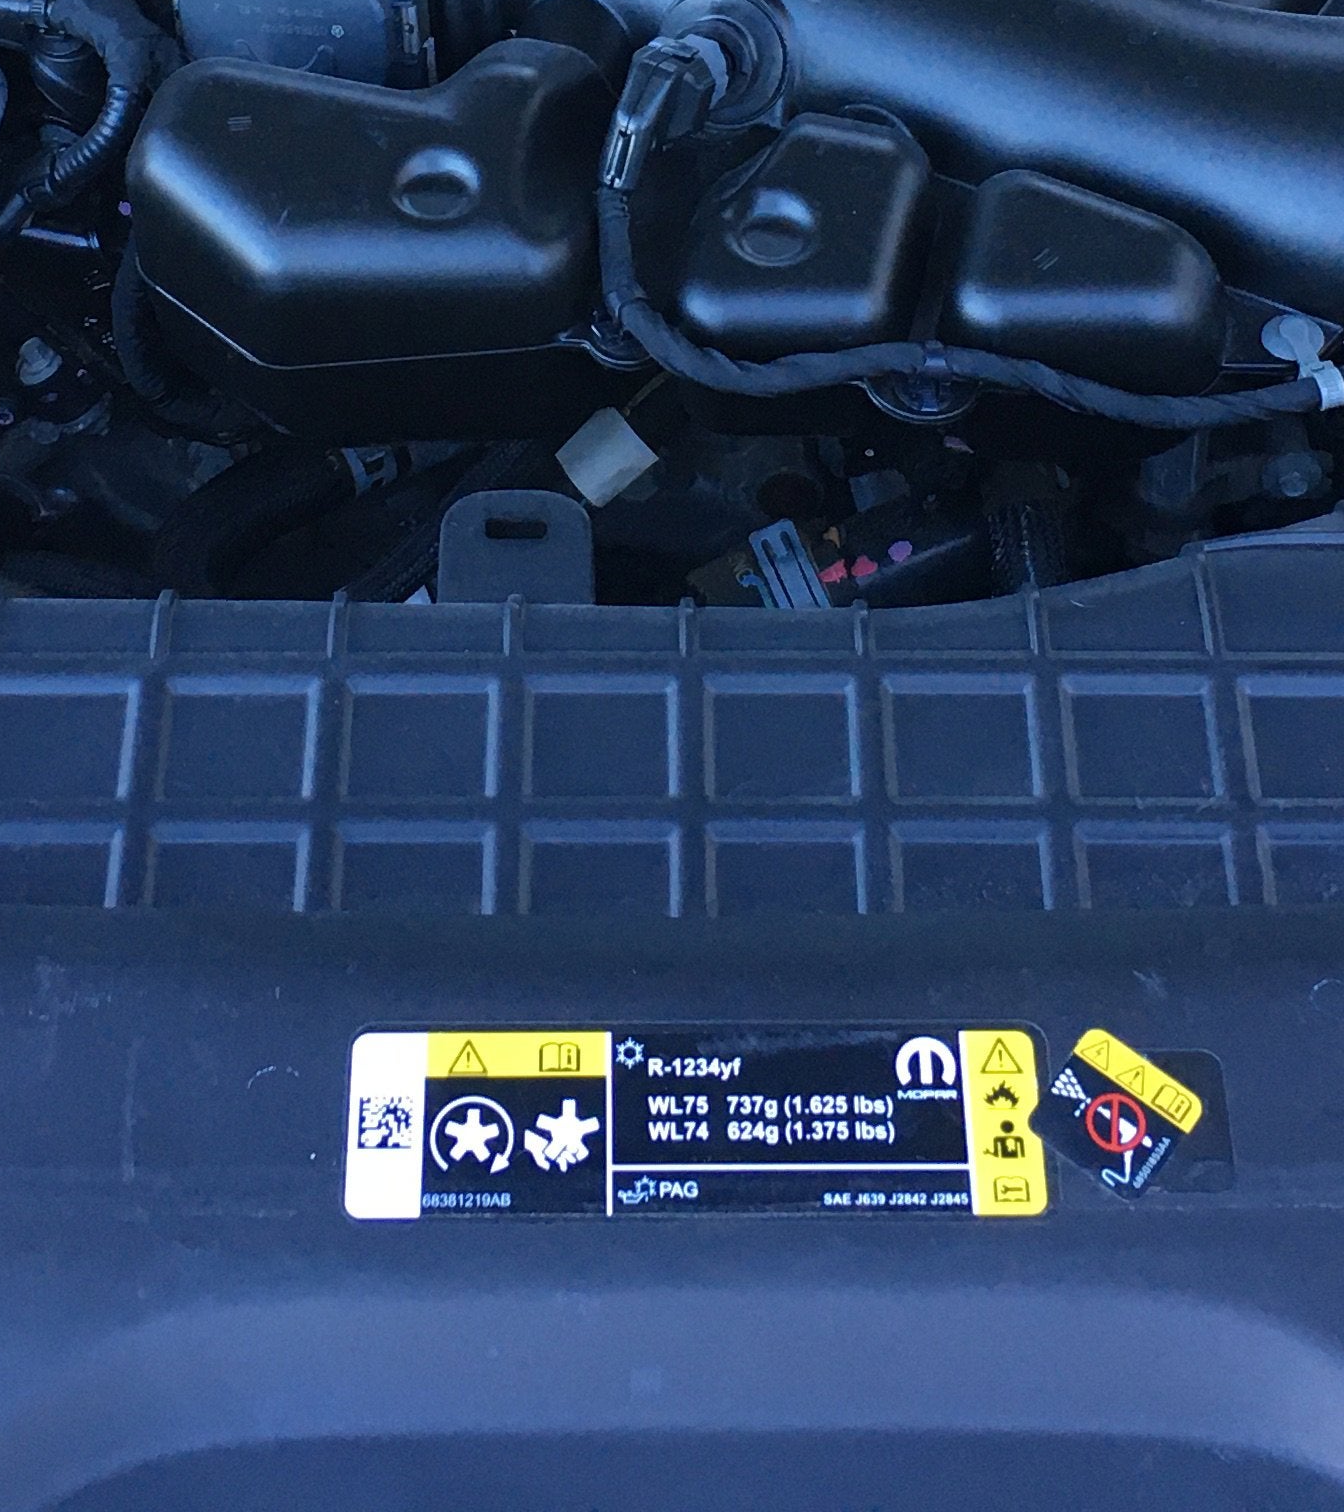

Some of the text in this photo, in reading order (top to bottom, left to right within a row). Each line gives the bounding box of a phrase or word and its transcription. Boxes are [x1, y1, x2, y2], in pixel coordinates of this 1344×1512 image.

[647, 1056, 742, 1082] R-1234yf
[897, 1089, 958, 1100] MOPAR
[647, 1094, 894, 1119] WL75 737g (1.625 lbs)
[647, 1120, 896, 1145] WL74 624g (1.375 lbs)
[659, 1180, 699, 1199] PAG
[823, 1192, 969, 1206] SAE J639 J2842 J2845
